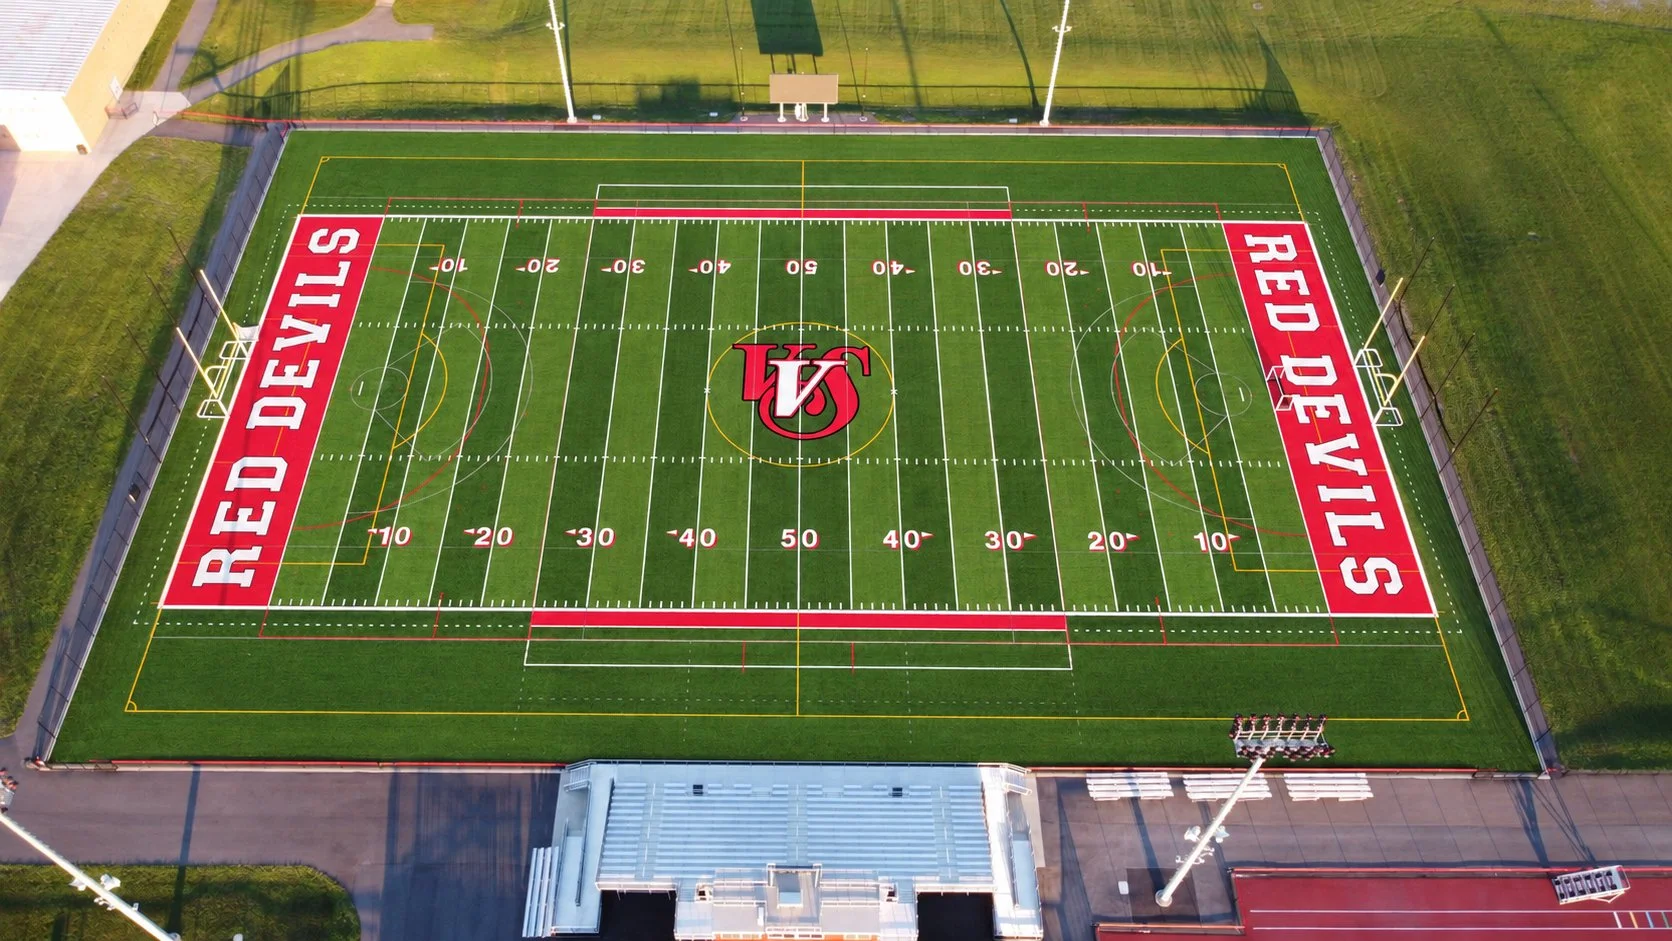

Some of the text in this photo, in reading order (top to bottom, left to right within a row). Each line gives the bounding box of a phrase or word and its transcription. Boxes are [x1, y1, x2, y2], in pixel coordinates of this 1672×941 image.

[439, 258, 468, 272] 10
[526, 258, 560, 273] 20
[612, 258, 645, 274] 30
[699, 259, 731, 275] 40
[786, 259, 818, 275] 50
[872, 260, 904, 275] 40
[957, 261, 991, 276] 30
[1046, 261, 1078, 276] 20
[1131, 262, 1162, 277] 10
[192, 227, 360, 588] RED DEVILS
[1243, 234, 1404, 596] RED DEVILS
[377, 526, 413, 546] 10
[473, 526, 514, 548] 20
[576, 527, 616, 548] 30
[678, 528, 718, 549] 40
[780, 528, 819, 549] 50
[882, 529, 922, 550] 40
[984, 531, 1024, 551] 30
[1087, 531, 1128, 552] 20
[1193, 531, 1230, 552] 10
